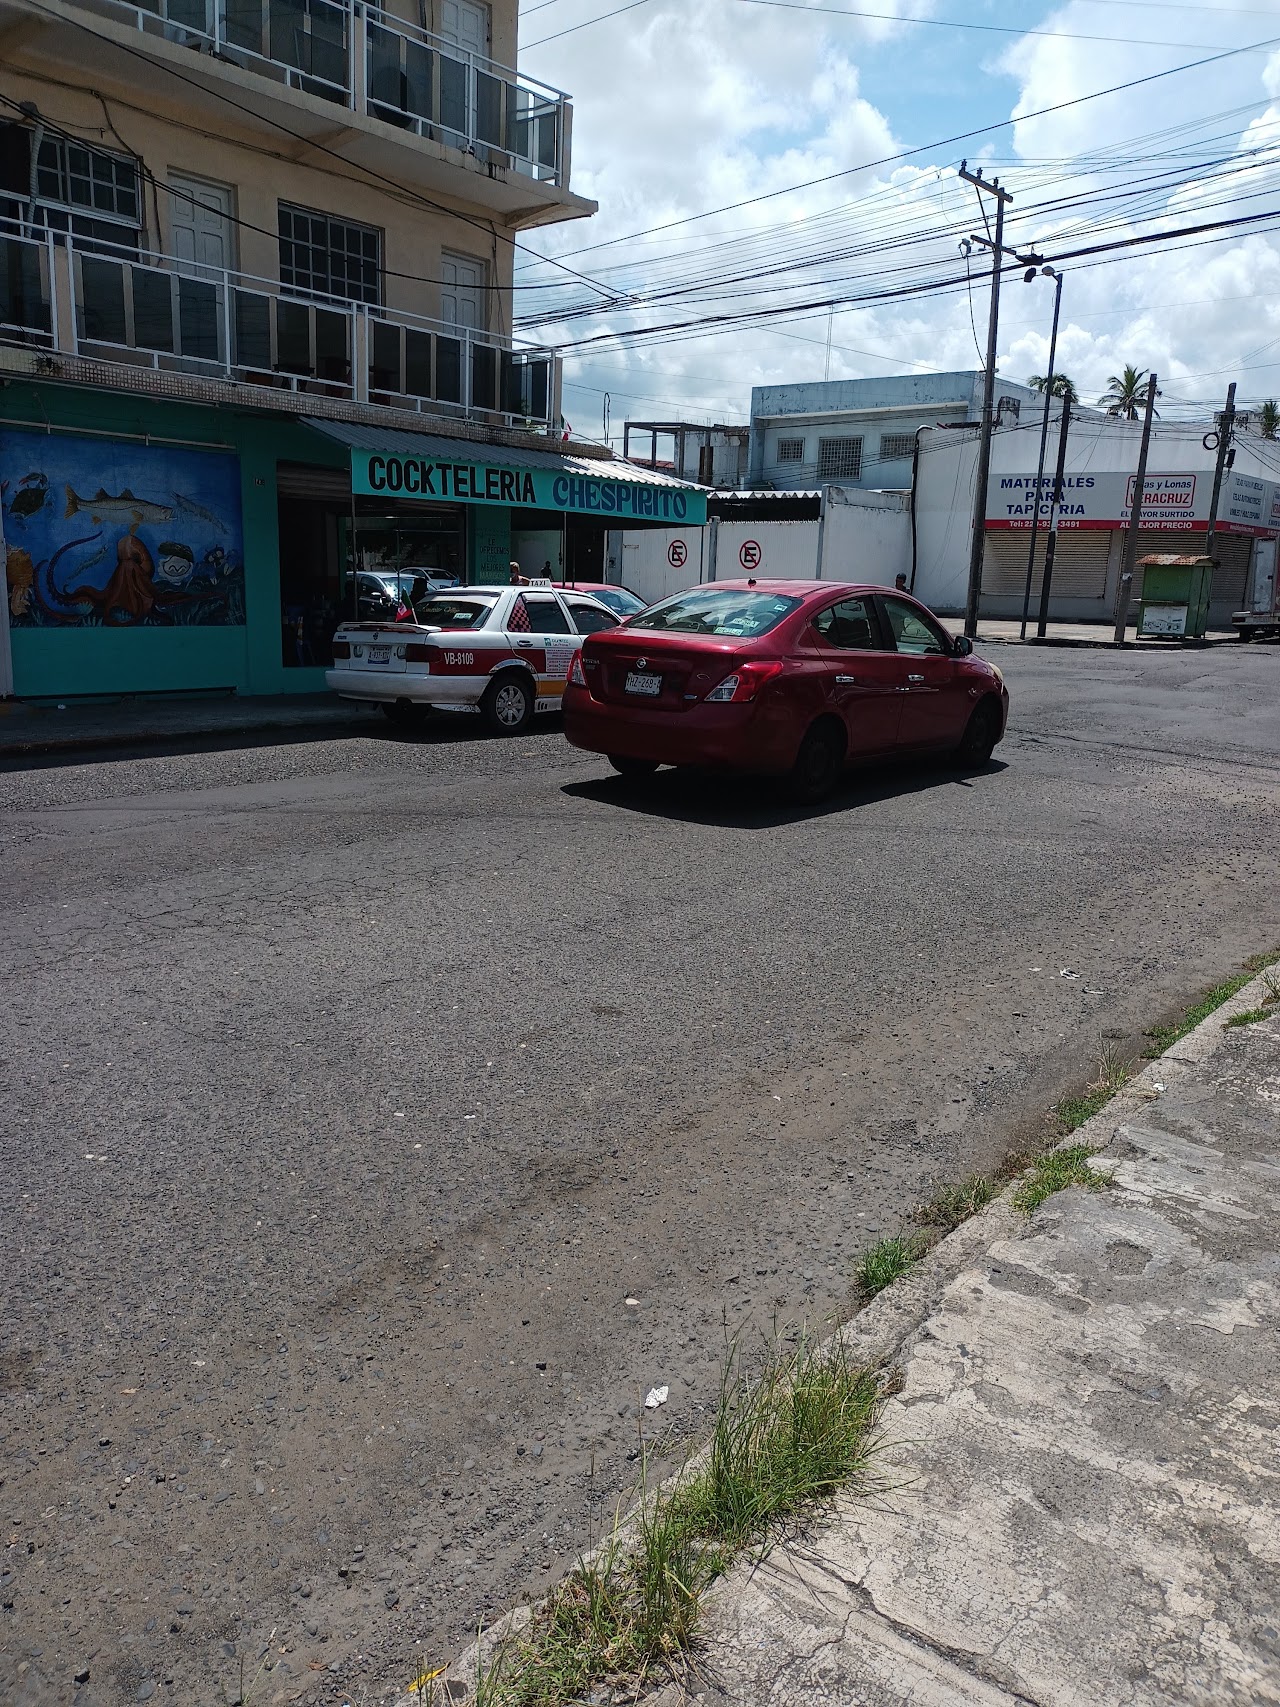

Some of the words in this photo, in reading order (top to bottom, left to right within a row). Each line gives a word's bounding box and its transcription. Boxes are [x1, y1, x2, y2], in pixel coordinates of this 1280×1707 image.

[368, 456, 537, 504] COCKTELERIA
[553, 475, 688, 520] CHESPIRITO
[1001, 477, 1095, 489] MATERIALES
[1131, 480, 1154, 489] Tas
[1156, 482, 1163, 491] y
[1164, 480, 1192, 489] Lonas
[1025, 491, 1065, 501] PARA
[1006, 504, 1085, 514] TAPCRIA
[1160, 521, 1193, 529] PRECIO
[443, 652, 474, 665] VB-8109
